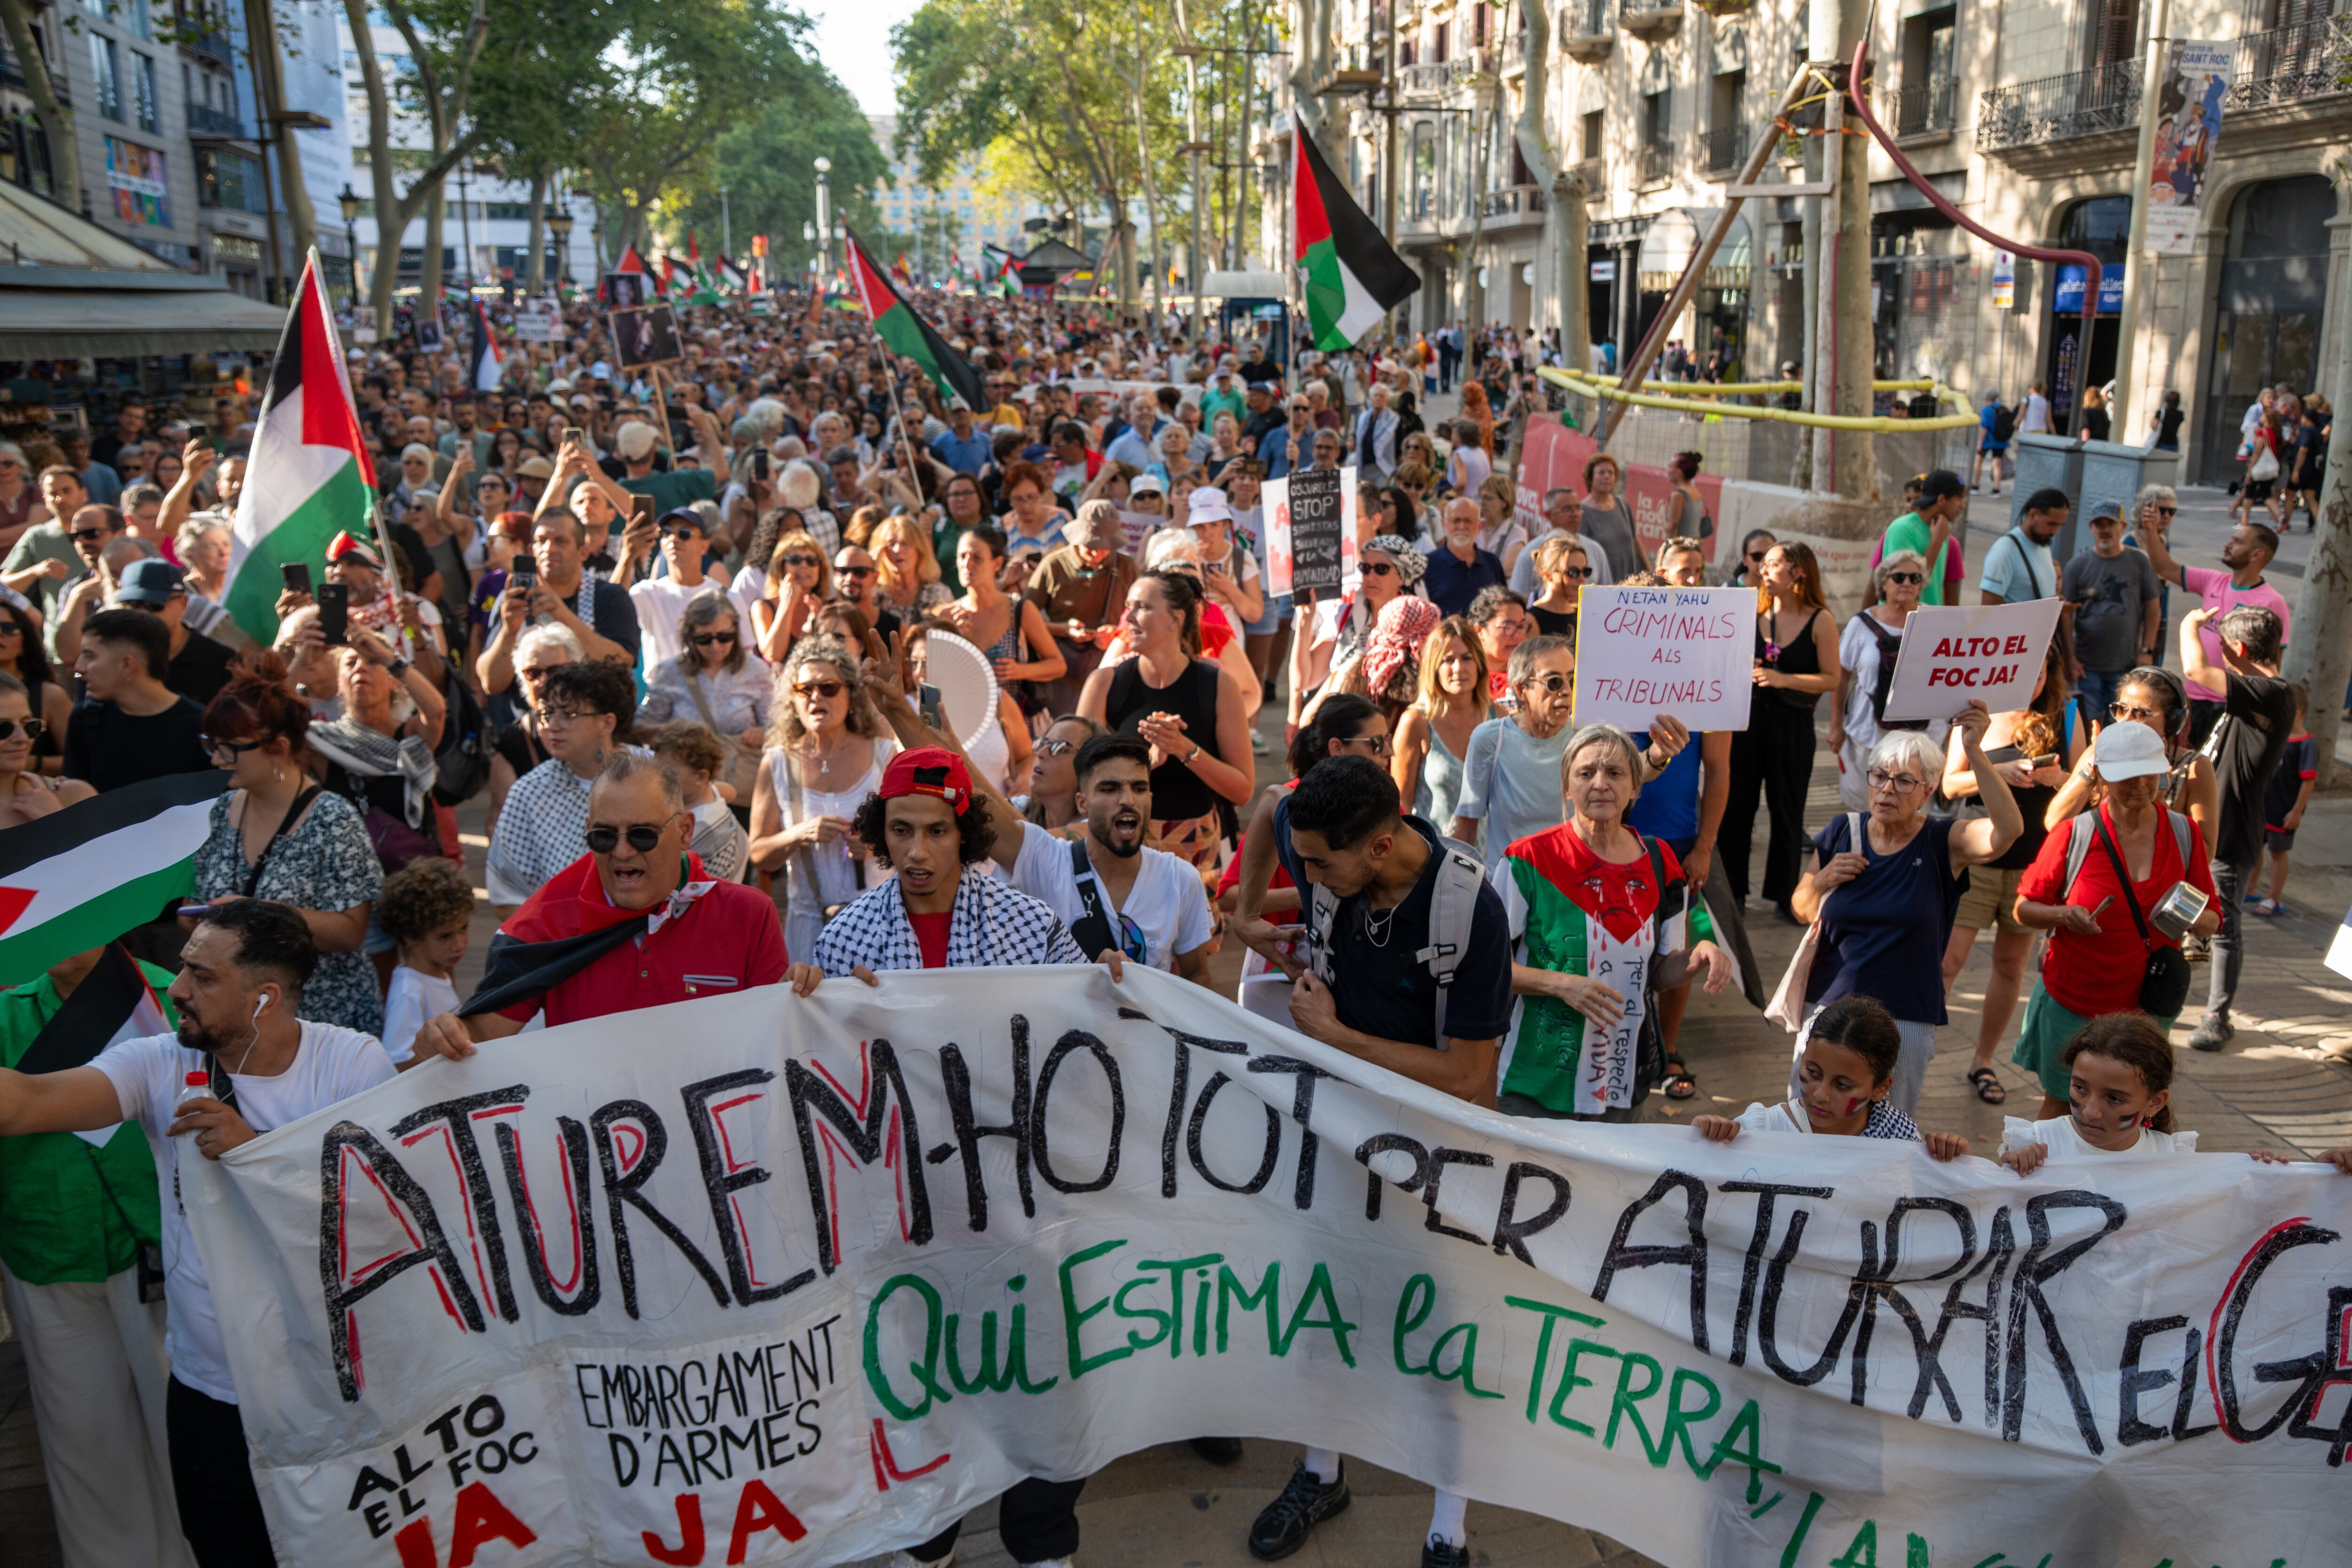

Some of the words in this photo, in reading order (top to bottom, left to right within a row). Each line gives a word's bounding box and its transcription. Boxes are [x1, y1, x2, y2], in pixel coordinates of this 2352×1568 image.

[2183, 53, 2208, 64] SANT
[2209, 54, 2230, 65] ROC
[1293, 495, 1335, 520] STOP
[1516, 486, 1538, 511] ova
[1637, 491, 1652, 509] la
[1604, 607, 1735, 640] CRIMINALS
[1651, 648, 1681, 663] ALS
[1931, 637, 2000, 657] ALTO
[2002, 635, 2028, 655] EL
[1595, 678, 1722, 705] TRIBUNALS
[1927, 667, 1980, 687] FOC
[1981, 664, 2019, 686] JA!
[1622, 956, 1645, 991] per
[1623, 999, 1642, 1017] al
[1605, 1028, 1631, 1102] respecte
[321, 1013, 1124, 1402] ATUREM-HO
[1117, 1007, 1355, 1210] TOT
[1355, 1132, 1571, 1270] PER
[2118, 1314, 2220, 1446] EL
[1393, 1272, 1505, 1400] la
[575, 1314, 842, 1429] EMBARGAMENT
[348, 1393, 505, 1511] ALTO
[607, 1398, 822, 1488] D'ARMES
[362, 1488, 426, 1539] EL
[447, 1432, 539, 1488] FOC
[640, 1478, 809, 1568] JA
